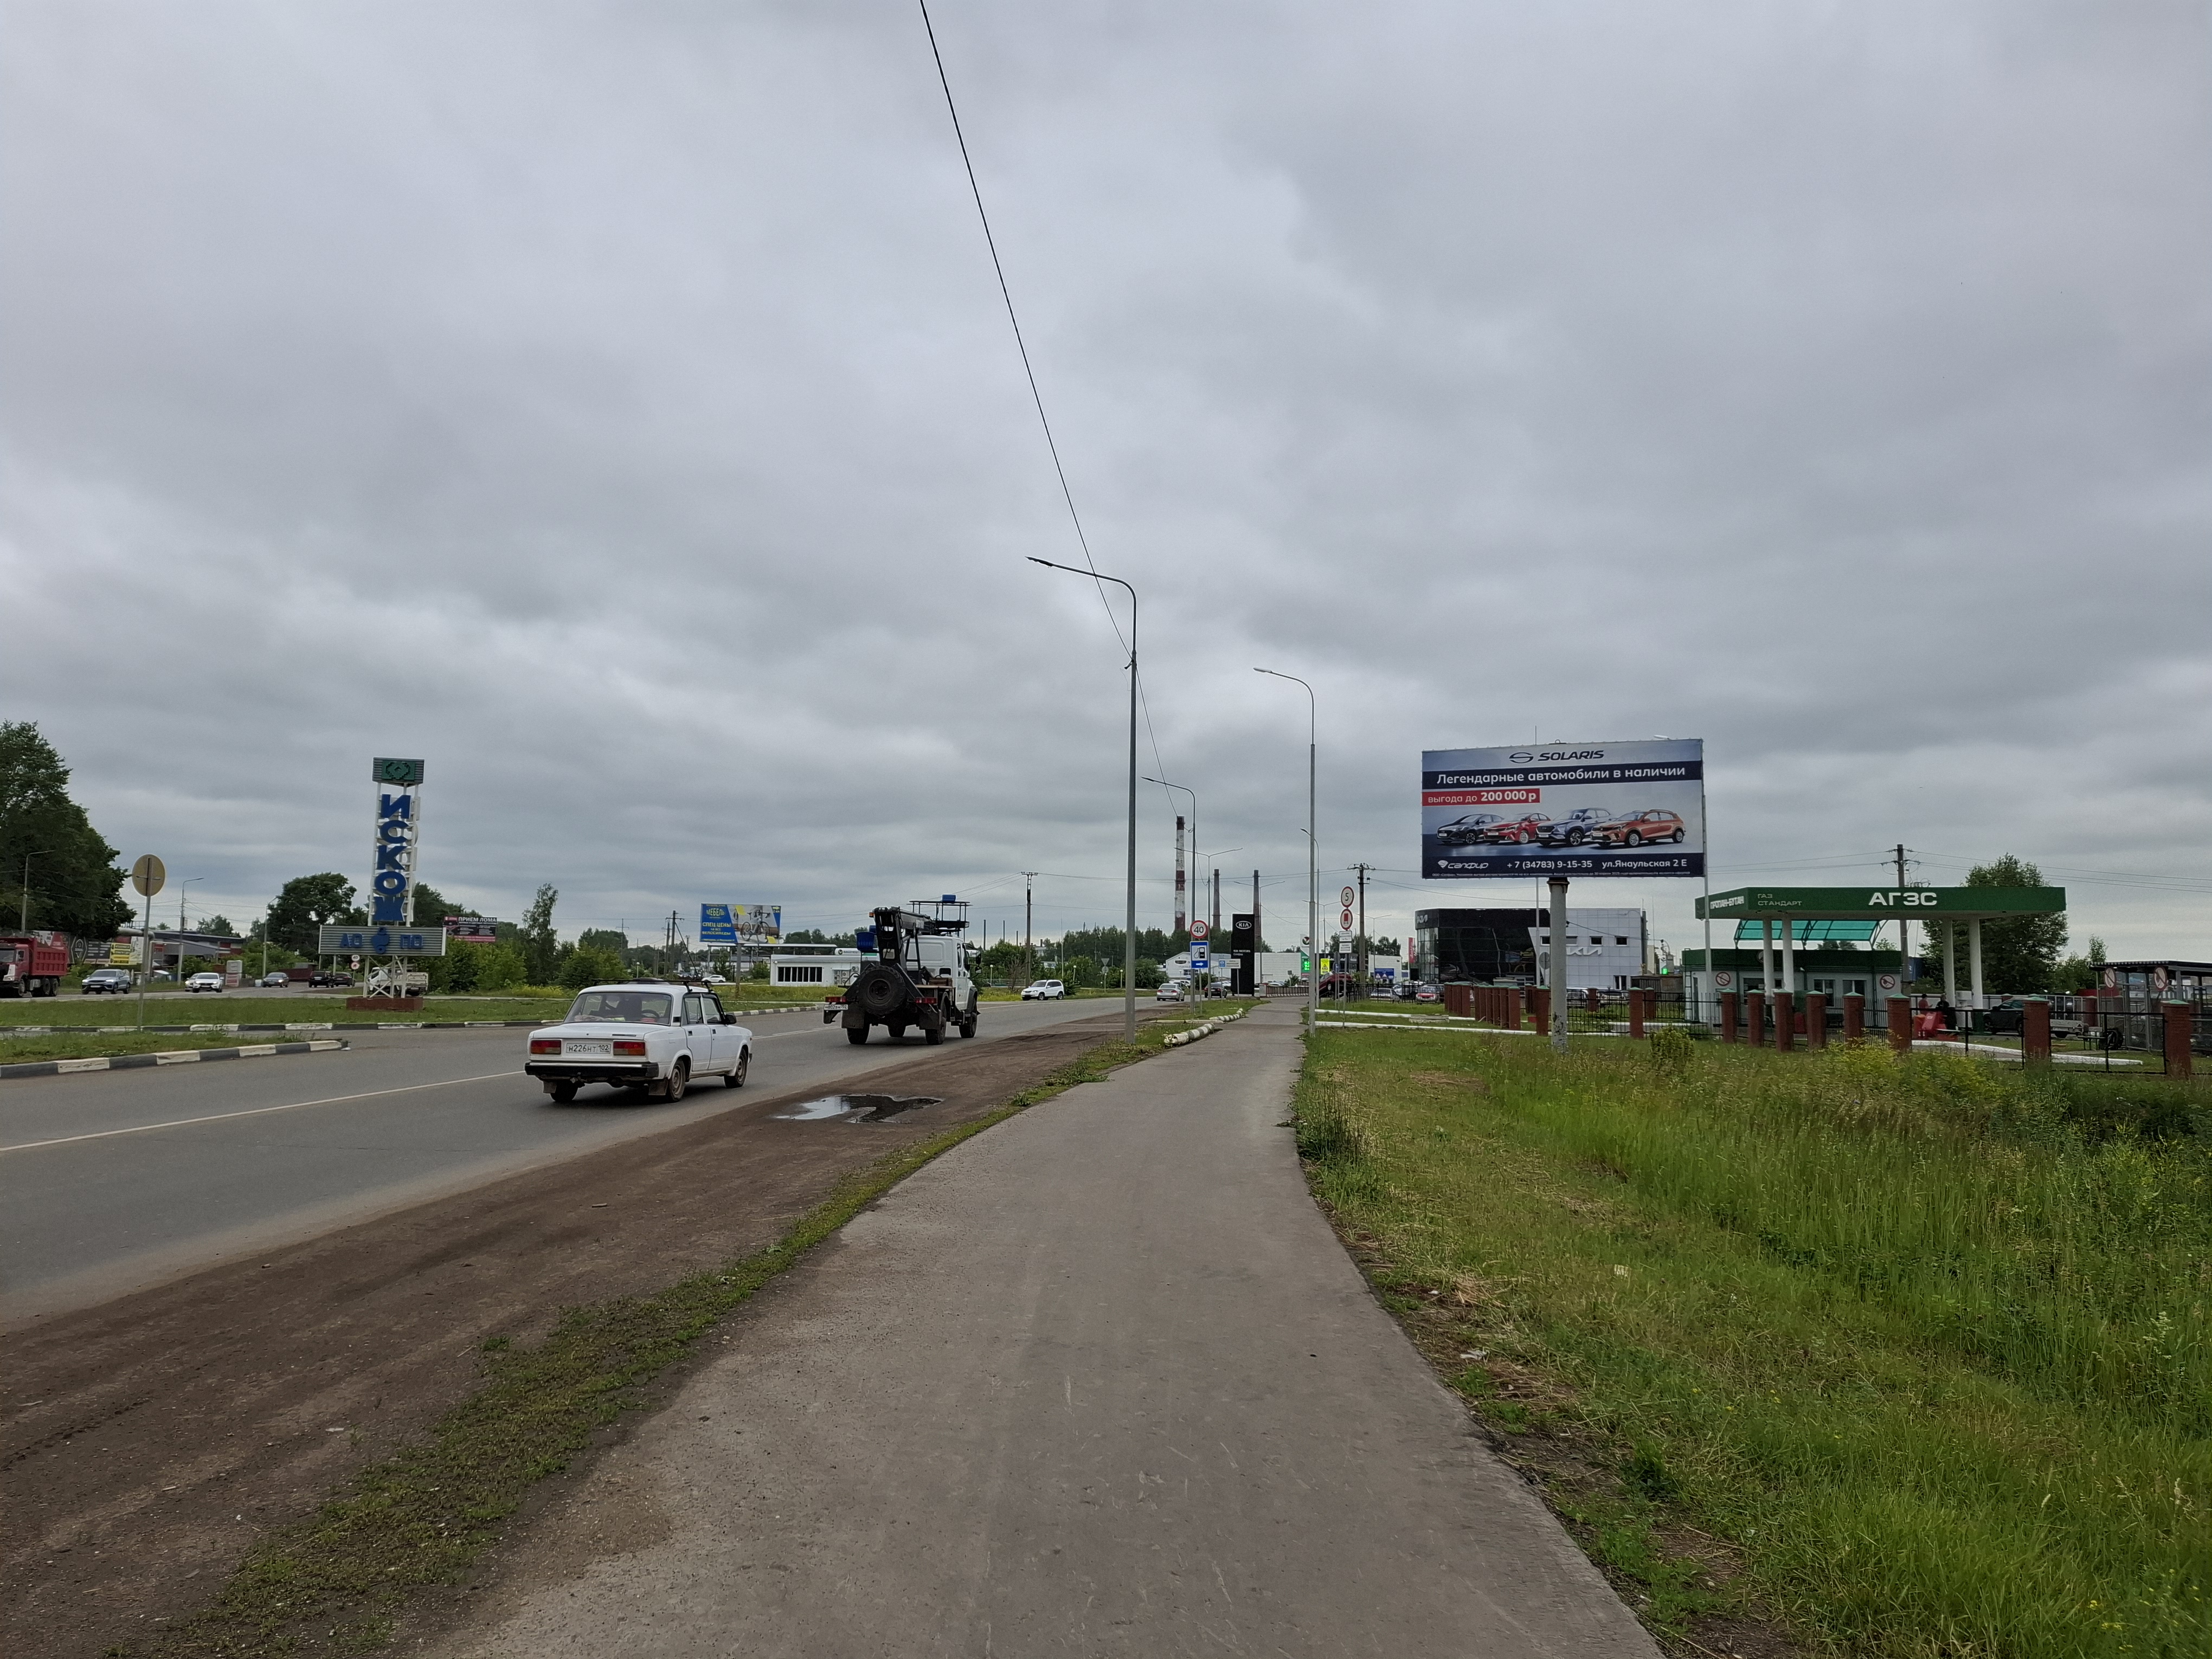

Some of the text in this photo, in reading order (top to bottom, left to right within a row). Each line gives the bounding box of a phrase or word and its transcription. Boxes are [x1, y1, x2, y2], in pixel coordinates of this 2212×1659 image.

[1538, 750, 1604, 762] SOLARIS
[1437, 773, 1524, 785] Легендарные
[1528, 769, 1609, 781] автомобили
[1625, 767, 1685, 777] наличии
[1481, 792, 1502, 801] 200
[1504, 790, 1526, 800] 000
[374, 794, 411, 922] ИСКОЖ
[1522, 860, 1554, 870] (34783)
[1602, 860, 1670, 869] ул.Янаульская
[1345, 892, 1349, 901] 5
[1868, 892, 1937, 905] АГЗС
[706, 908, 725, 916] МЕБЕЛЬ
[569, 1044, 597, 1052] Н226НТ
